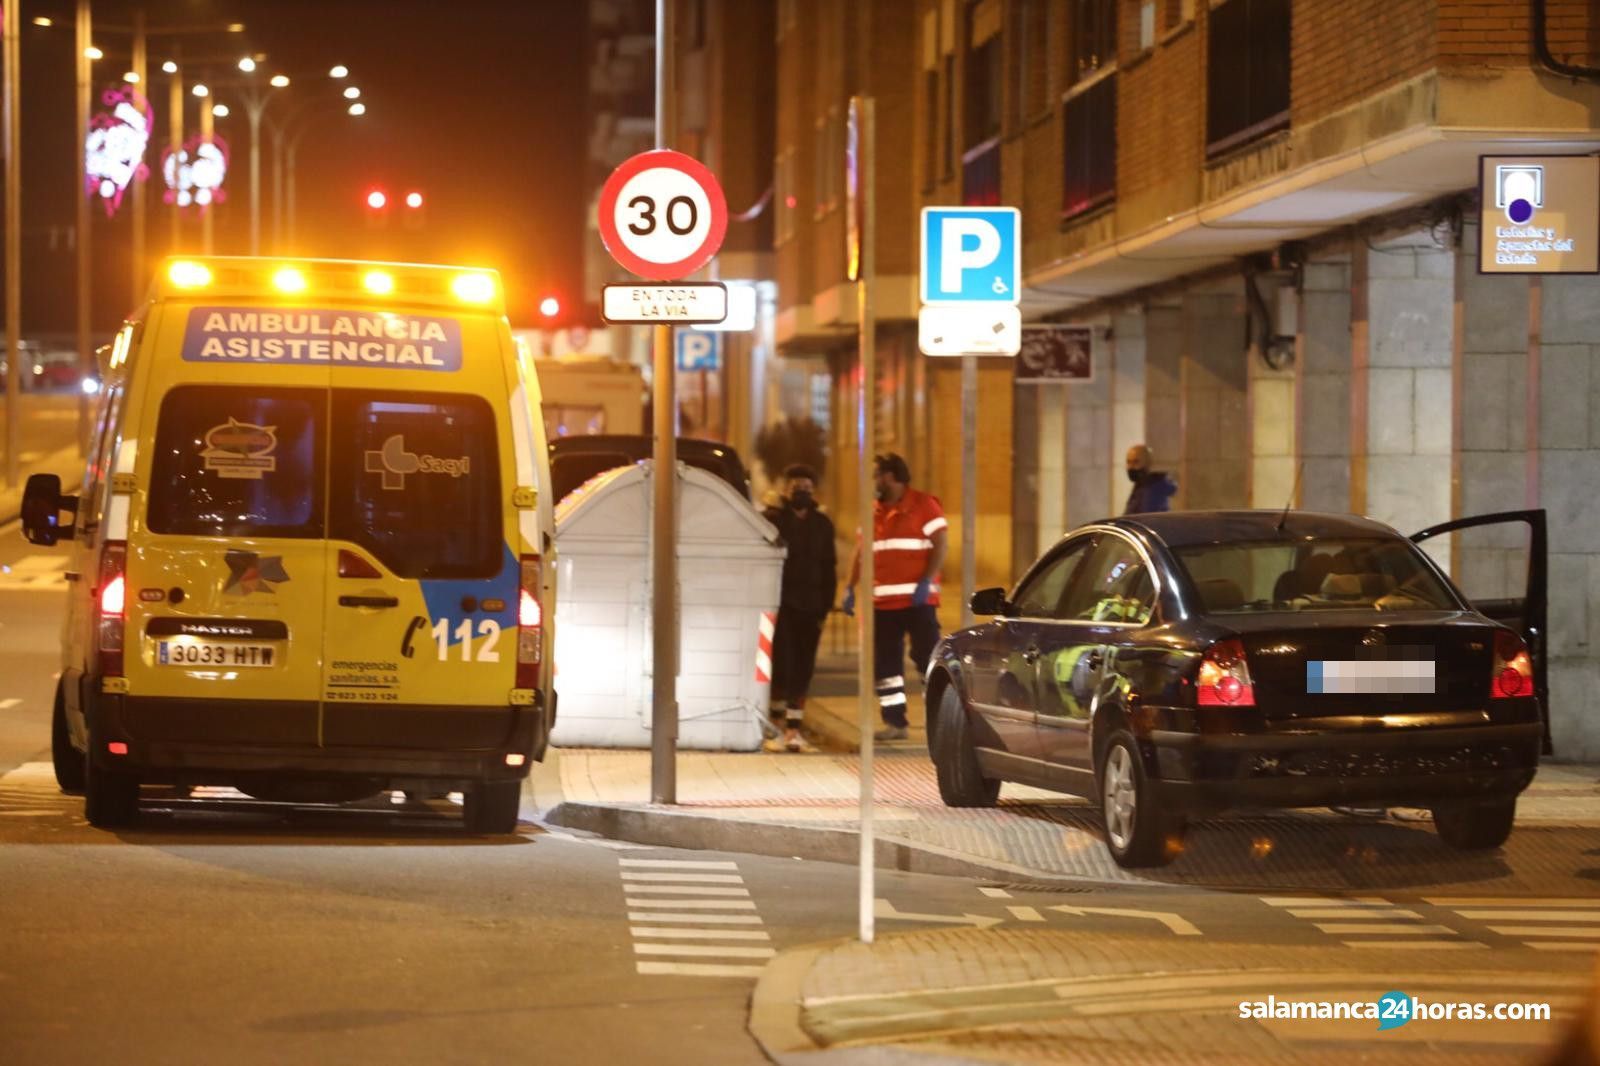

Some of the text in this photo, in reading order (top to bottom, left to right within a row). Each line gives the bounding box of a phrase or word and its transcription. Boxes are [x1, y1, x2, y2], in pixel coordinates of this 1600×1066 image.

[628, 195, 698, 236] 30
[940, 217, 1001, 293] P
[632, 289, 652, 301] EN
[641, 305, 660, 317] LA
[203, 312, 447, 342] AMBULANCIA
[201, 337, 444, 366] ASISTENCIAL
[684, 334, 711, 368] P
[173, 645, 273, 665] 3033 HTW
[432, 618, 500, 663] 112
[332, 661, 398, 671] emergencias
